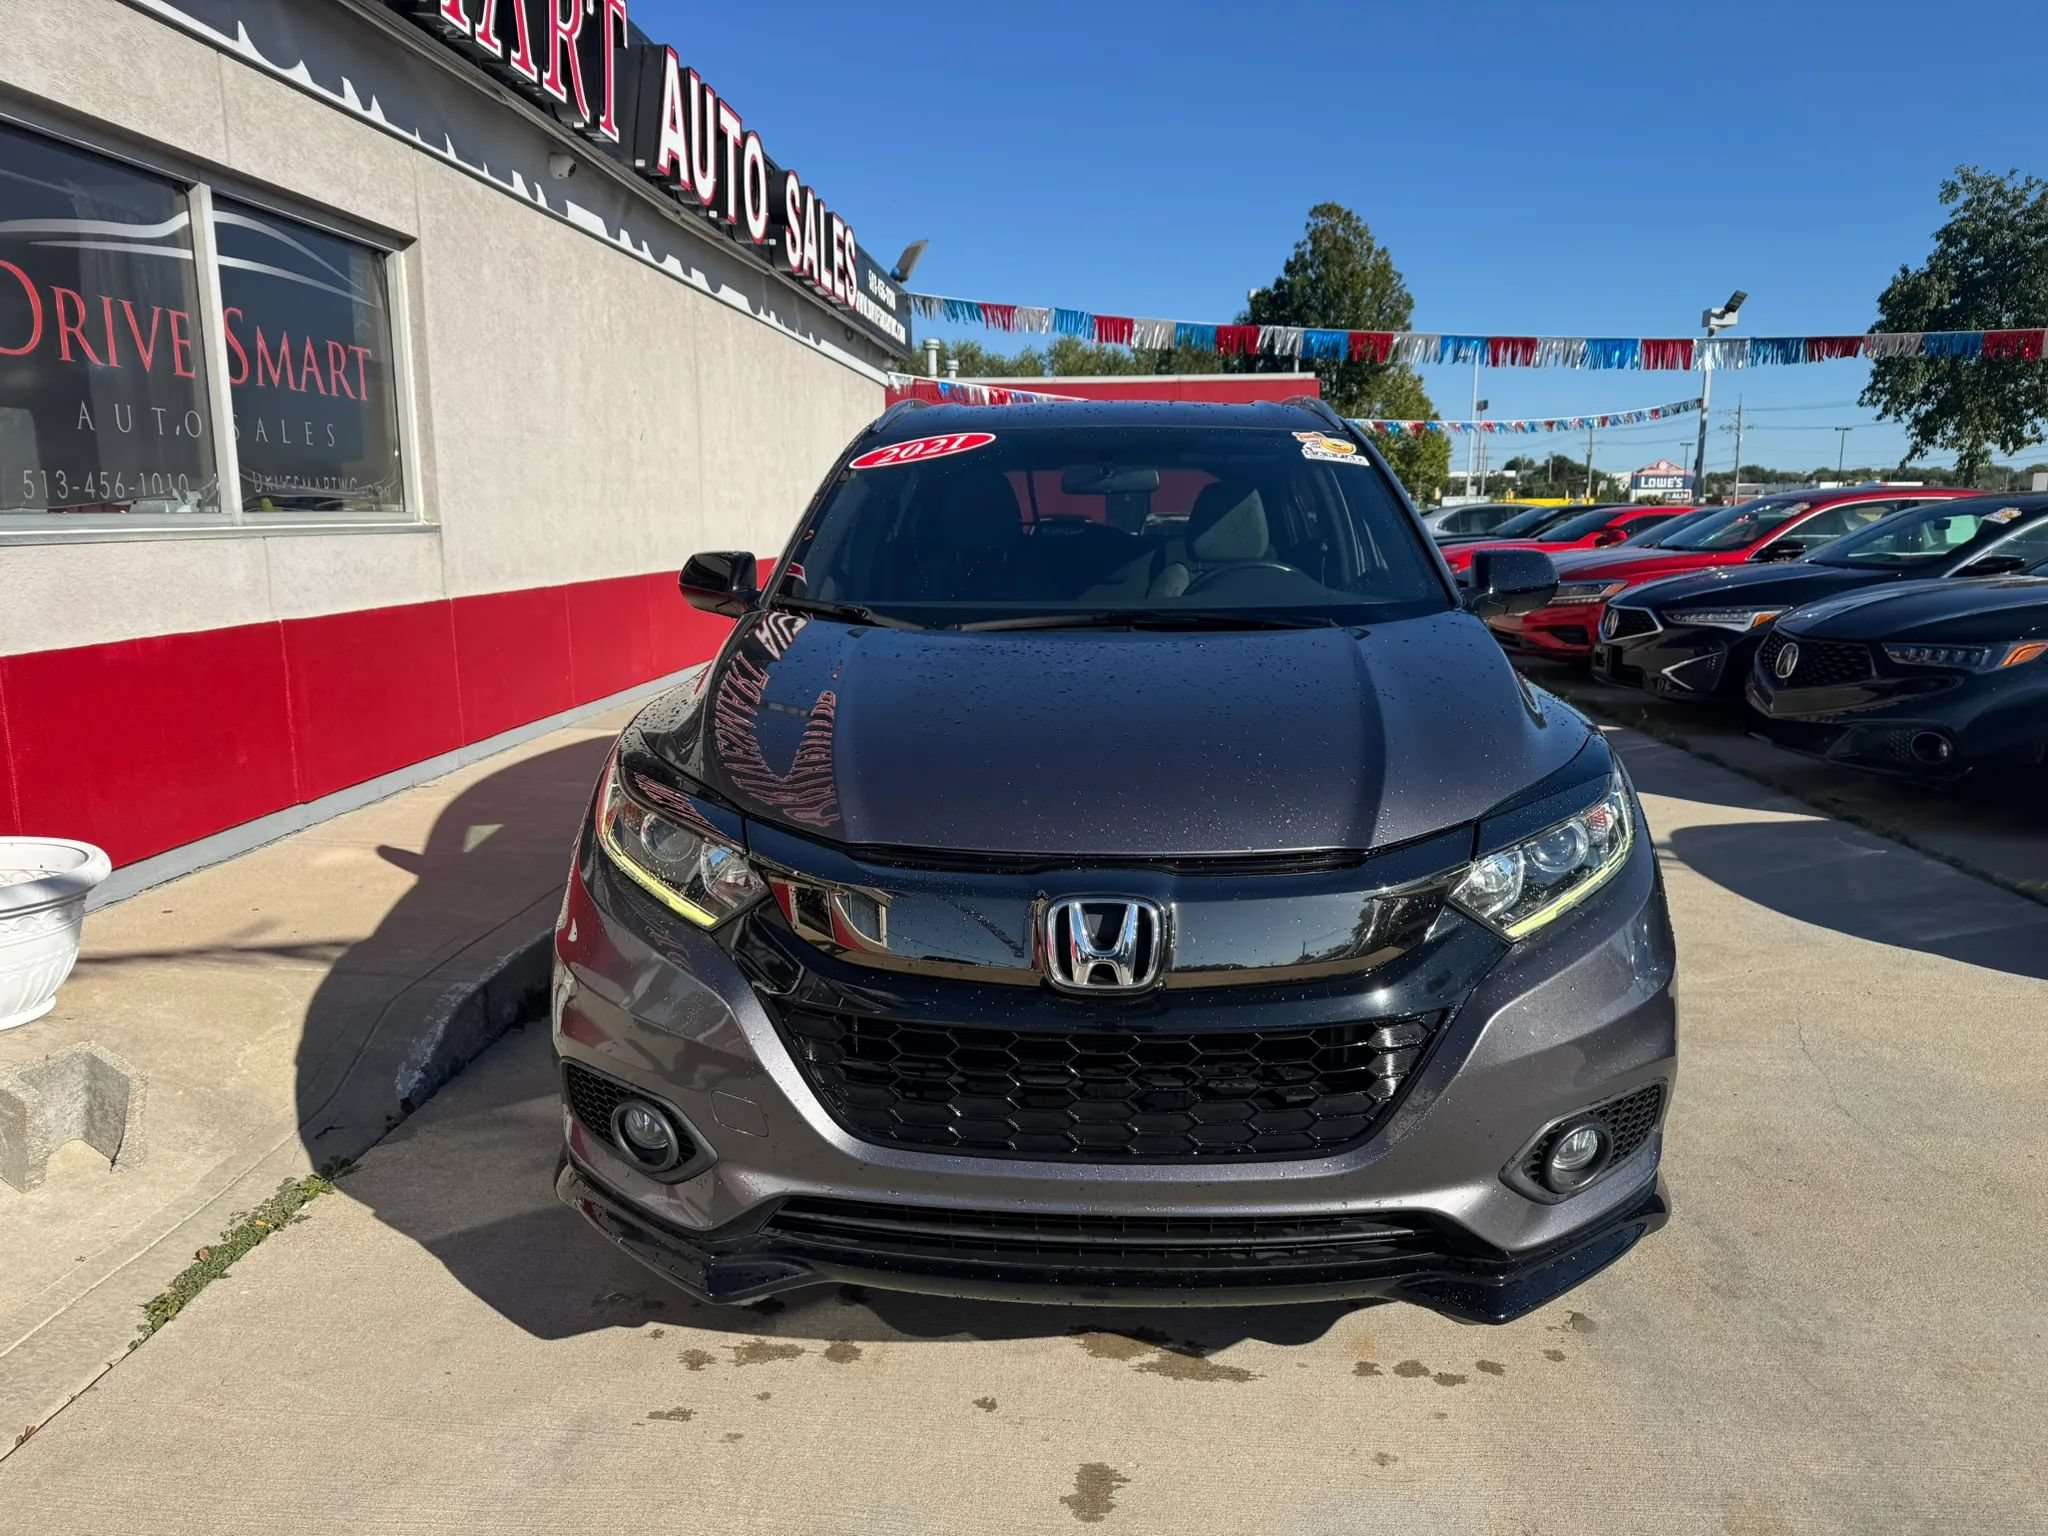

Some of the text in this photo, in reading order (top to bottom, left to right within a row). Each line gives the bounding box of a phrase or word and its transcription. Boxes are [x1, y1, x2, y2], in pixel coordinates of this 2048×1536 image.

[440, 0, 857, 312] RT AUTO SALES
[0, 259, 373, 401] DRIVE SMART
[77, 399, 202, 438] AUTO
[873, 434, 969, 466] 2021
[23, 469, 190, 500] 513-456-1010
[1640, 476, 1684, 489] LOWE'S
